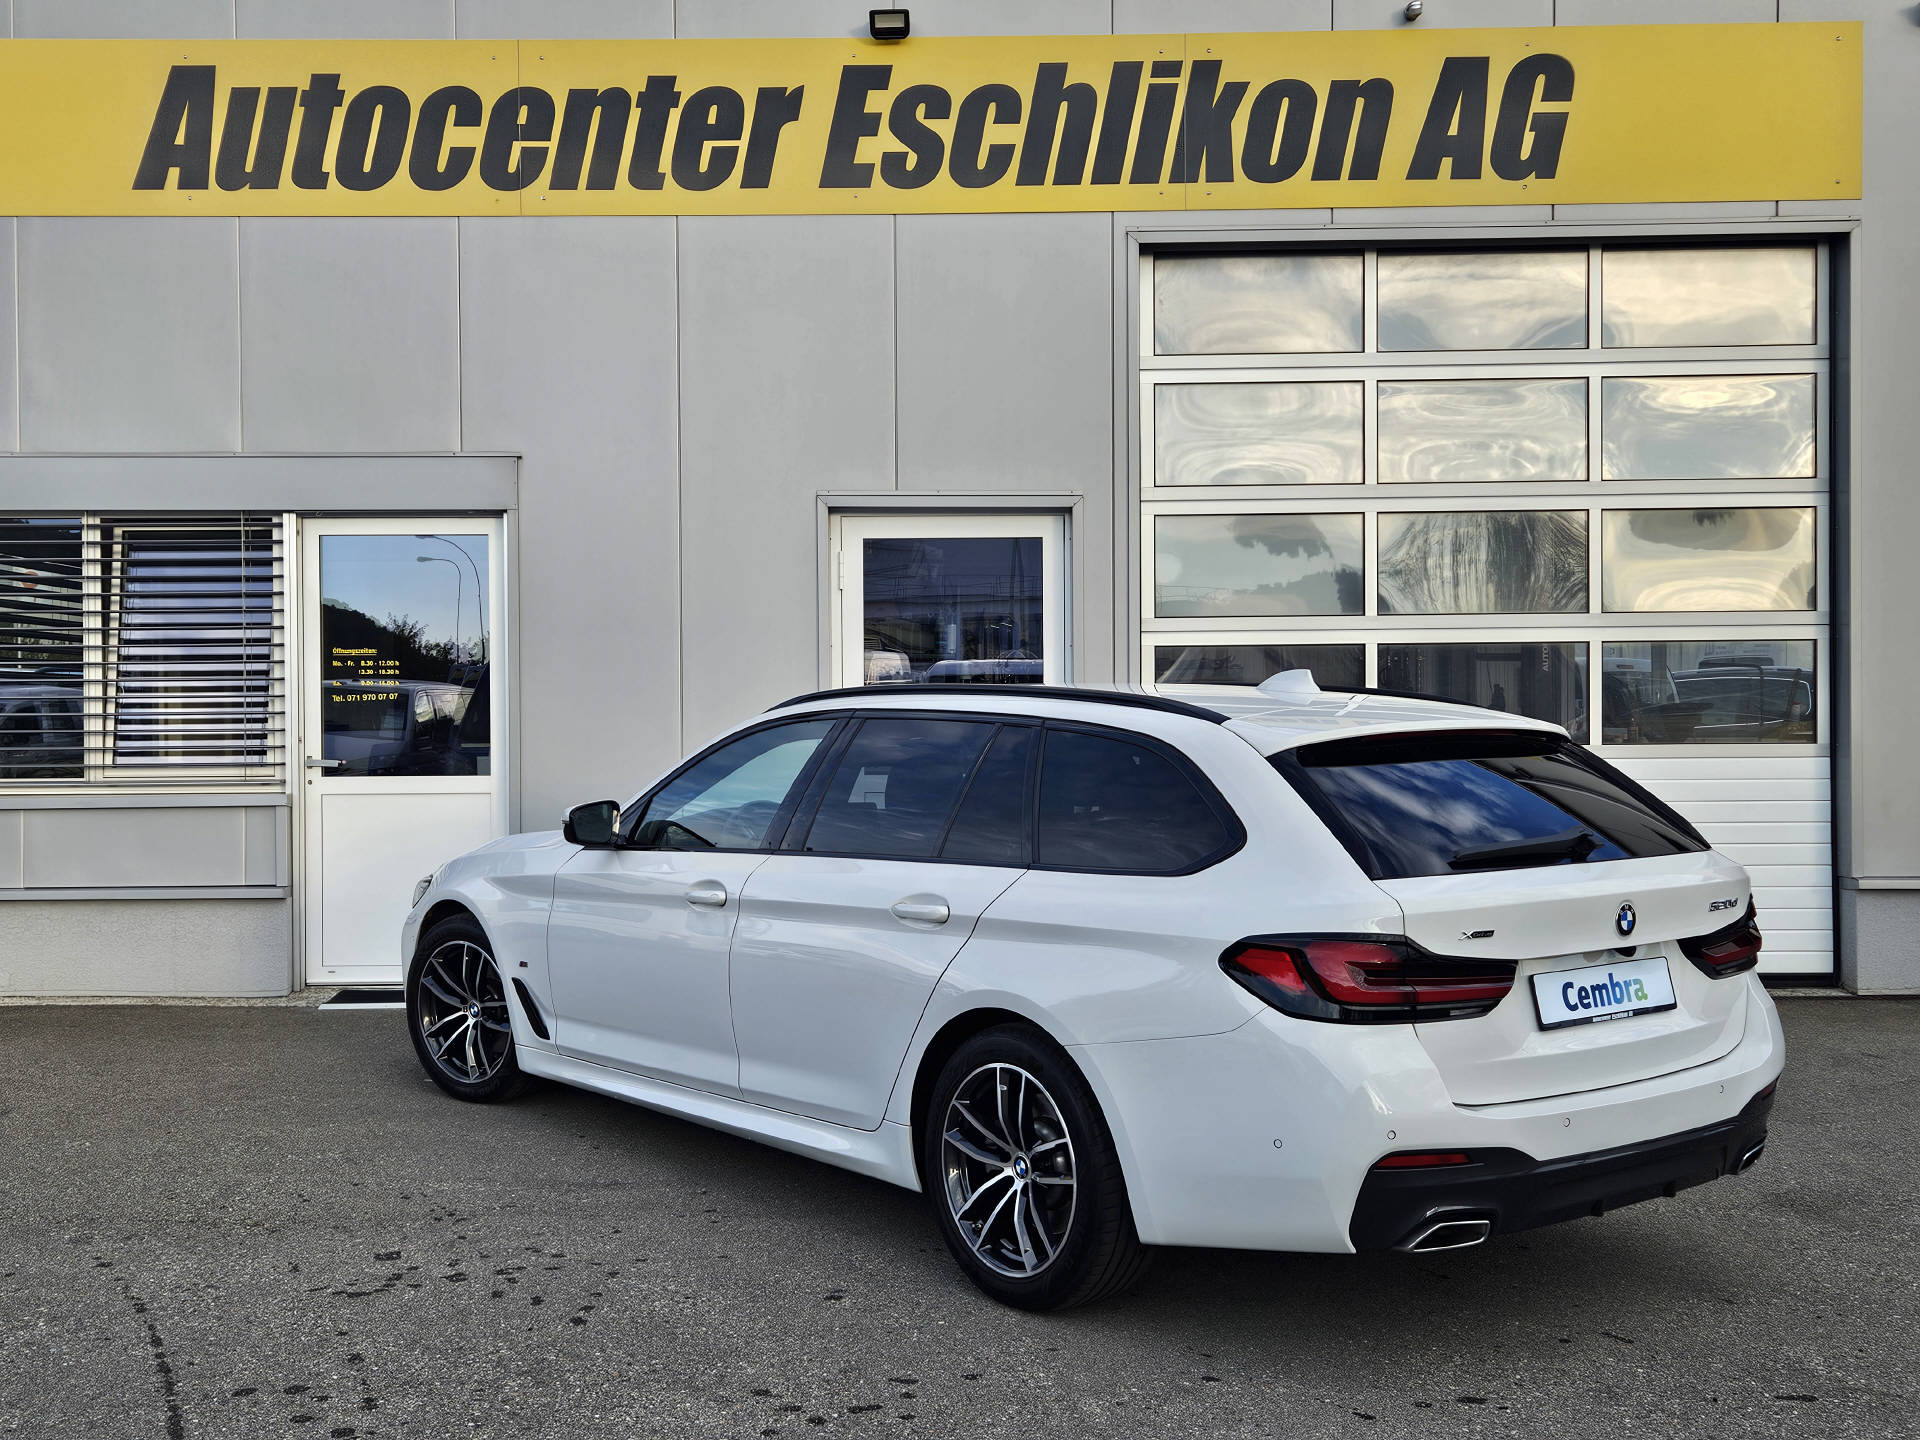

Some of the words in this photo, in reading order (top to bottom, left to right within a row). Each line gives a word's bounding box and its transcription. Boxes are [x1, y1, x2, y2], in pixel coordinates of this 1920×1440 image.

[132, 64, 804, 192] Autocenter
[819, 60, 1395, 189] Eschlikon
[1406, 54, 1575, 182] AG
[332, 694, 346, 702] Tel.
[346, 694, 360, 702] 071
[362, 693, 376, 701] 970
[378, 693, 387, 701] 07
[389, 692, 399, 700] 07
[1562, 972, 1648, 1011] Cembra
